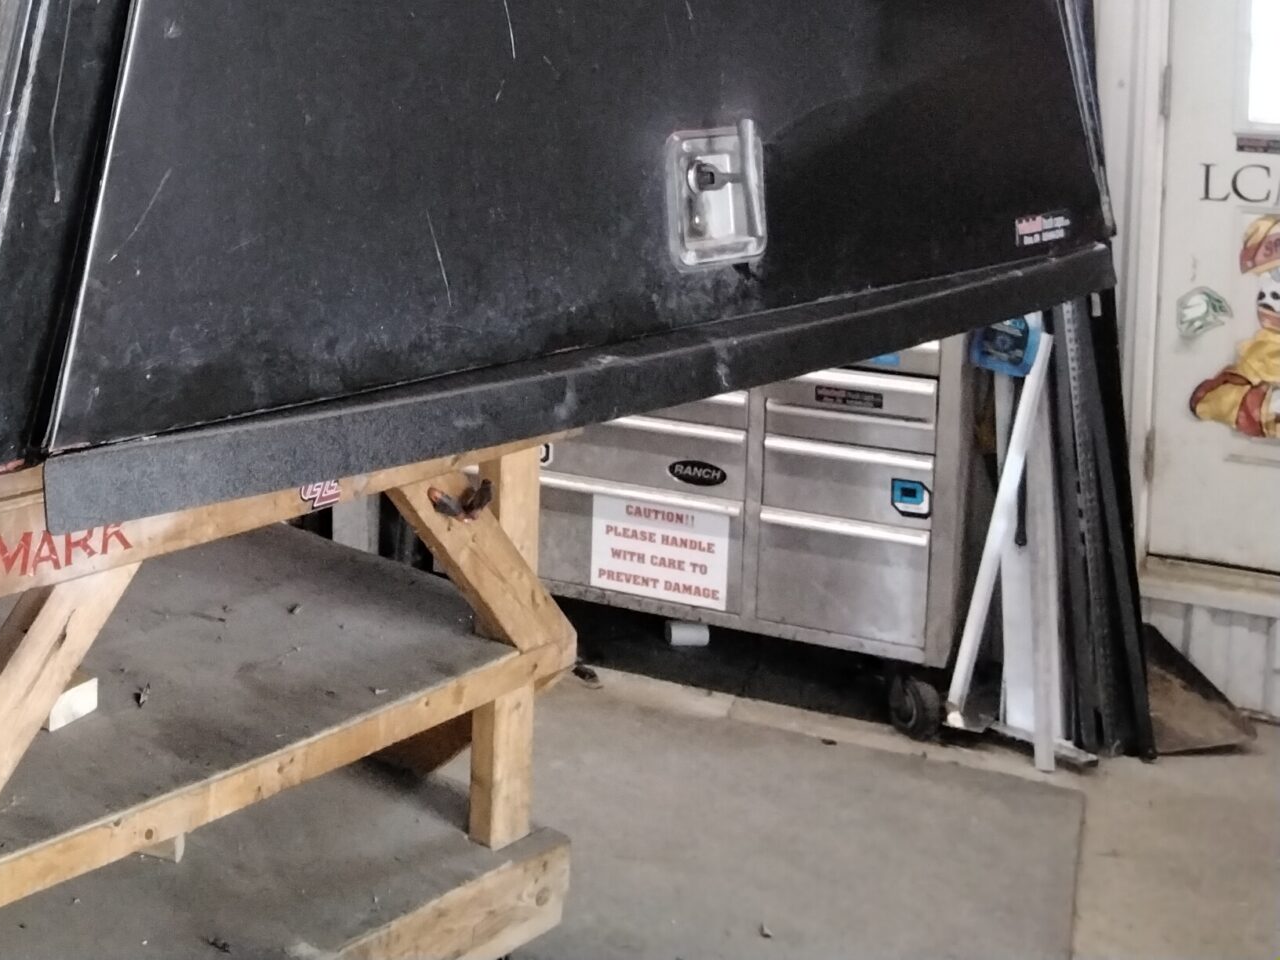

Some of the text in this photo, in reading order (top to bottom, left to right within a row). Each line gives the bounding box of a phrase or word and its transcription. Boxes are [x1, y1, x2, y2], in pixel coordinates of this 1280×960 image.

[673, 464, 722, 480] RANCH
[625, 504, 695, 529] CAUTION!!
[605, 524, 716, 555] PLEASE HANDLE
[610, 547, 708, 575] WITH CARE TO
[598, 567, 720, 601] PREVENT DAMAGE
